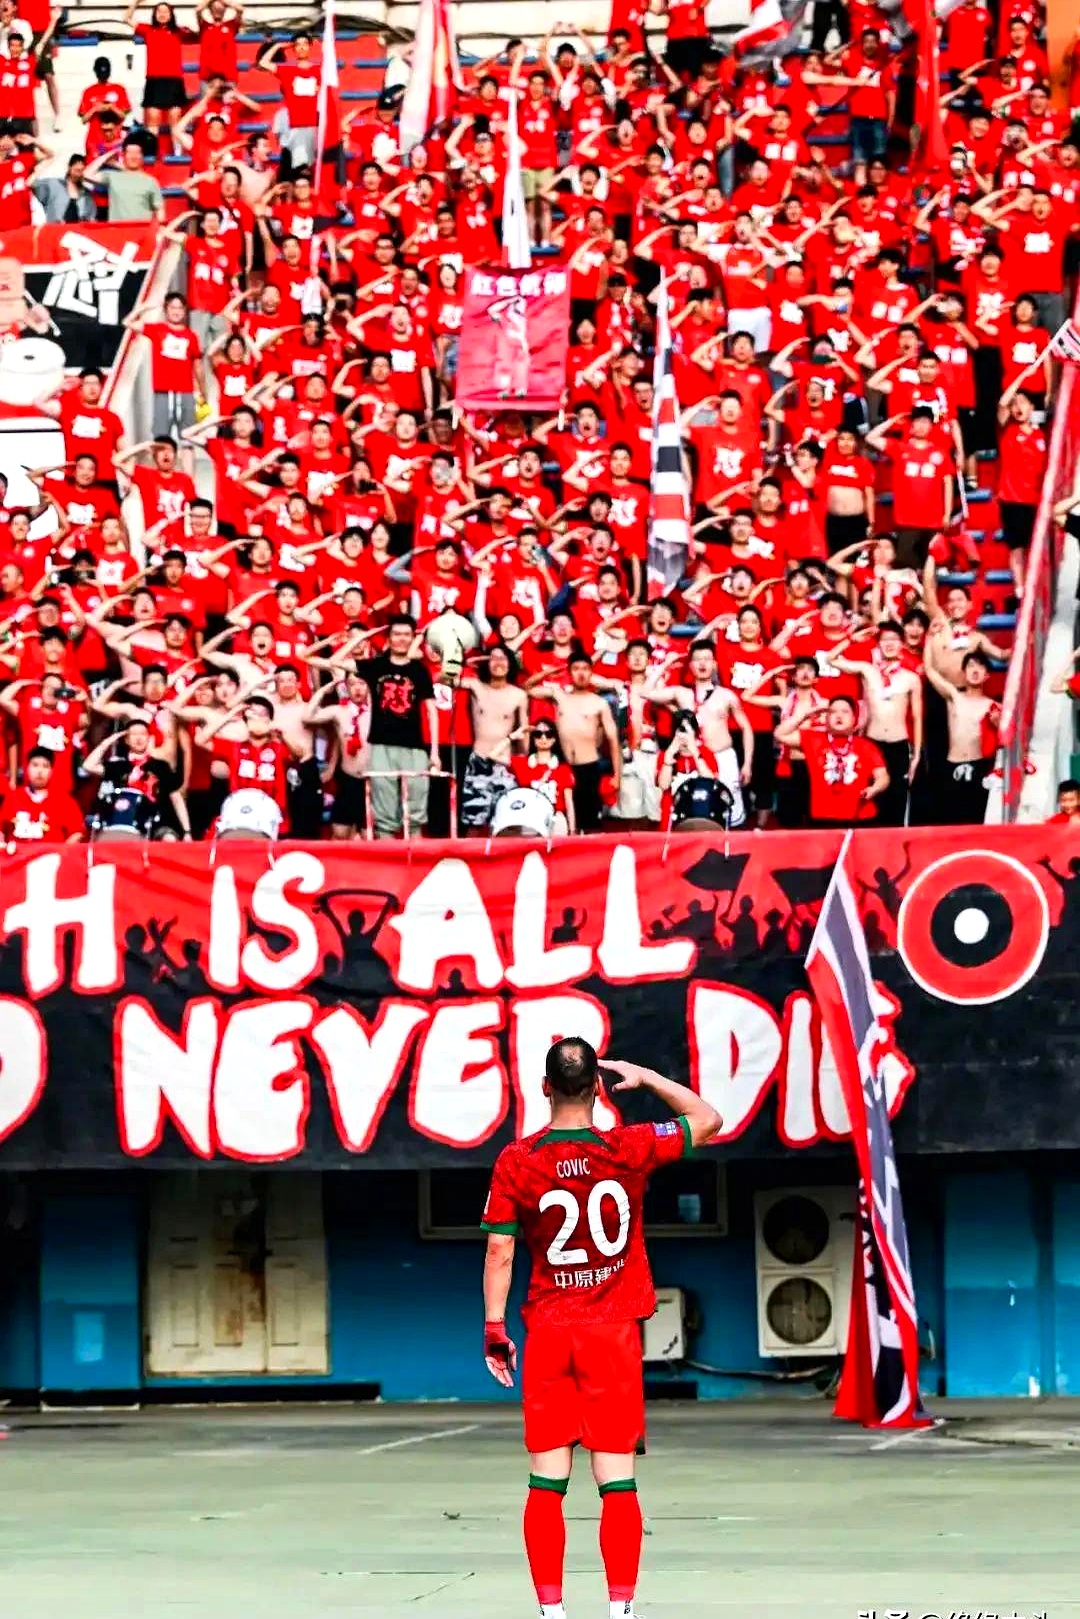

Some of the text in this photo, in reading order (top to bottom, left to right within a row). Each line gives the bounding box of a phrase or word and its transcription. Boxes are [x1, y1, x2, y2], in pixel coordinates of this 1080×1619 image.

[208, 851, 325, 990] IS
[387, 845, 697, 991] ALL
[116, 994, 620, 1158] NEVER
[538, 1179, 631, 1265] 20
[556, 1158, 591, 1179] COVIC
